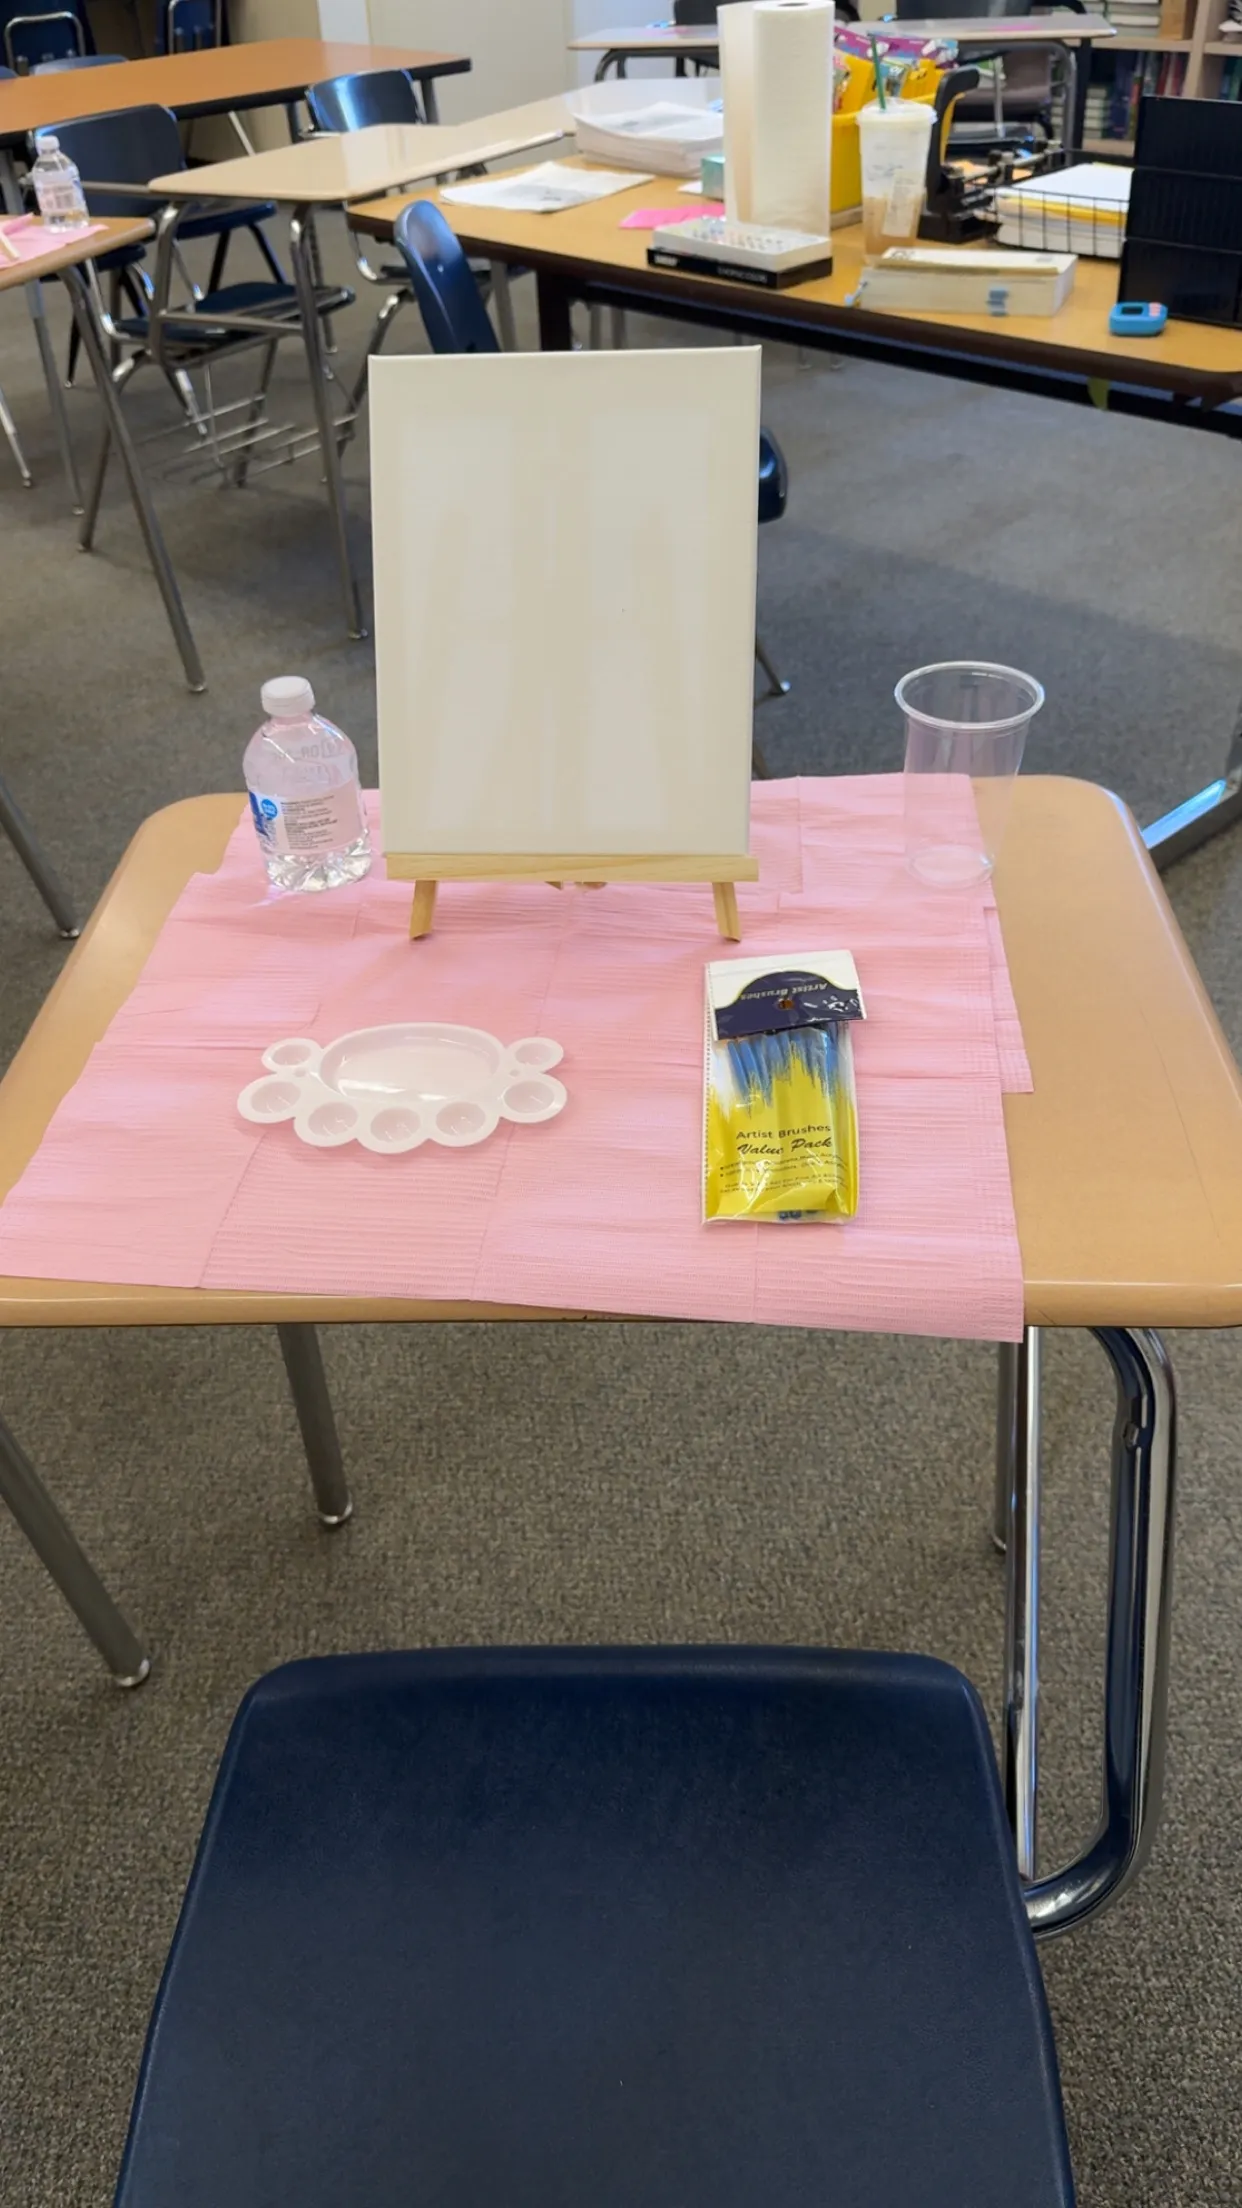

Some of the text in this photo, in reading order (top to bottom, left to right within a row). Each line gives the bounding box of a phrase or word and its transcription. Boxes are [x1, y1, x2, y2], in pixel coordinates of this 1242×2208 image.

[736, 1125, 831, 1139] Artist Brushes
[737, 1137, 832, 1154] Value Pack
